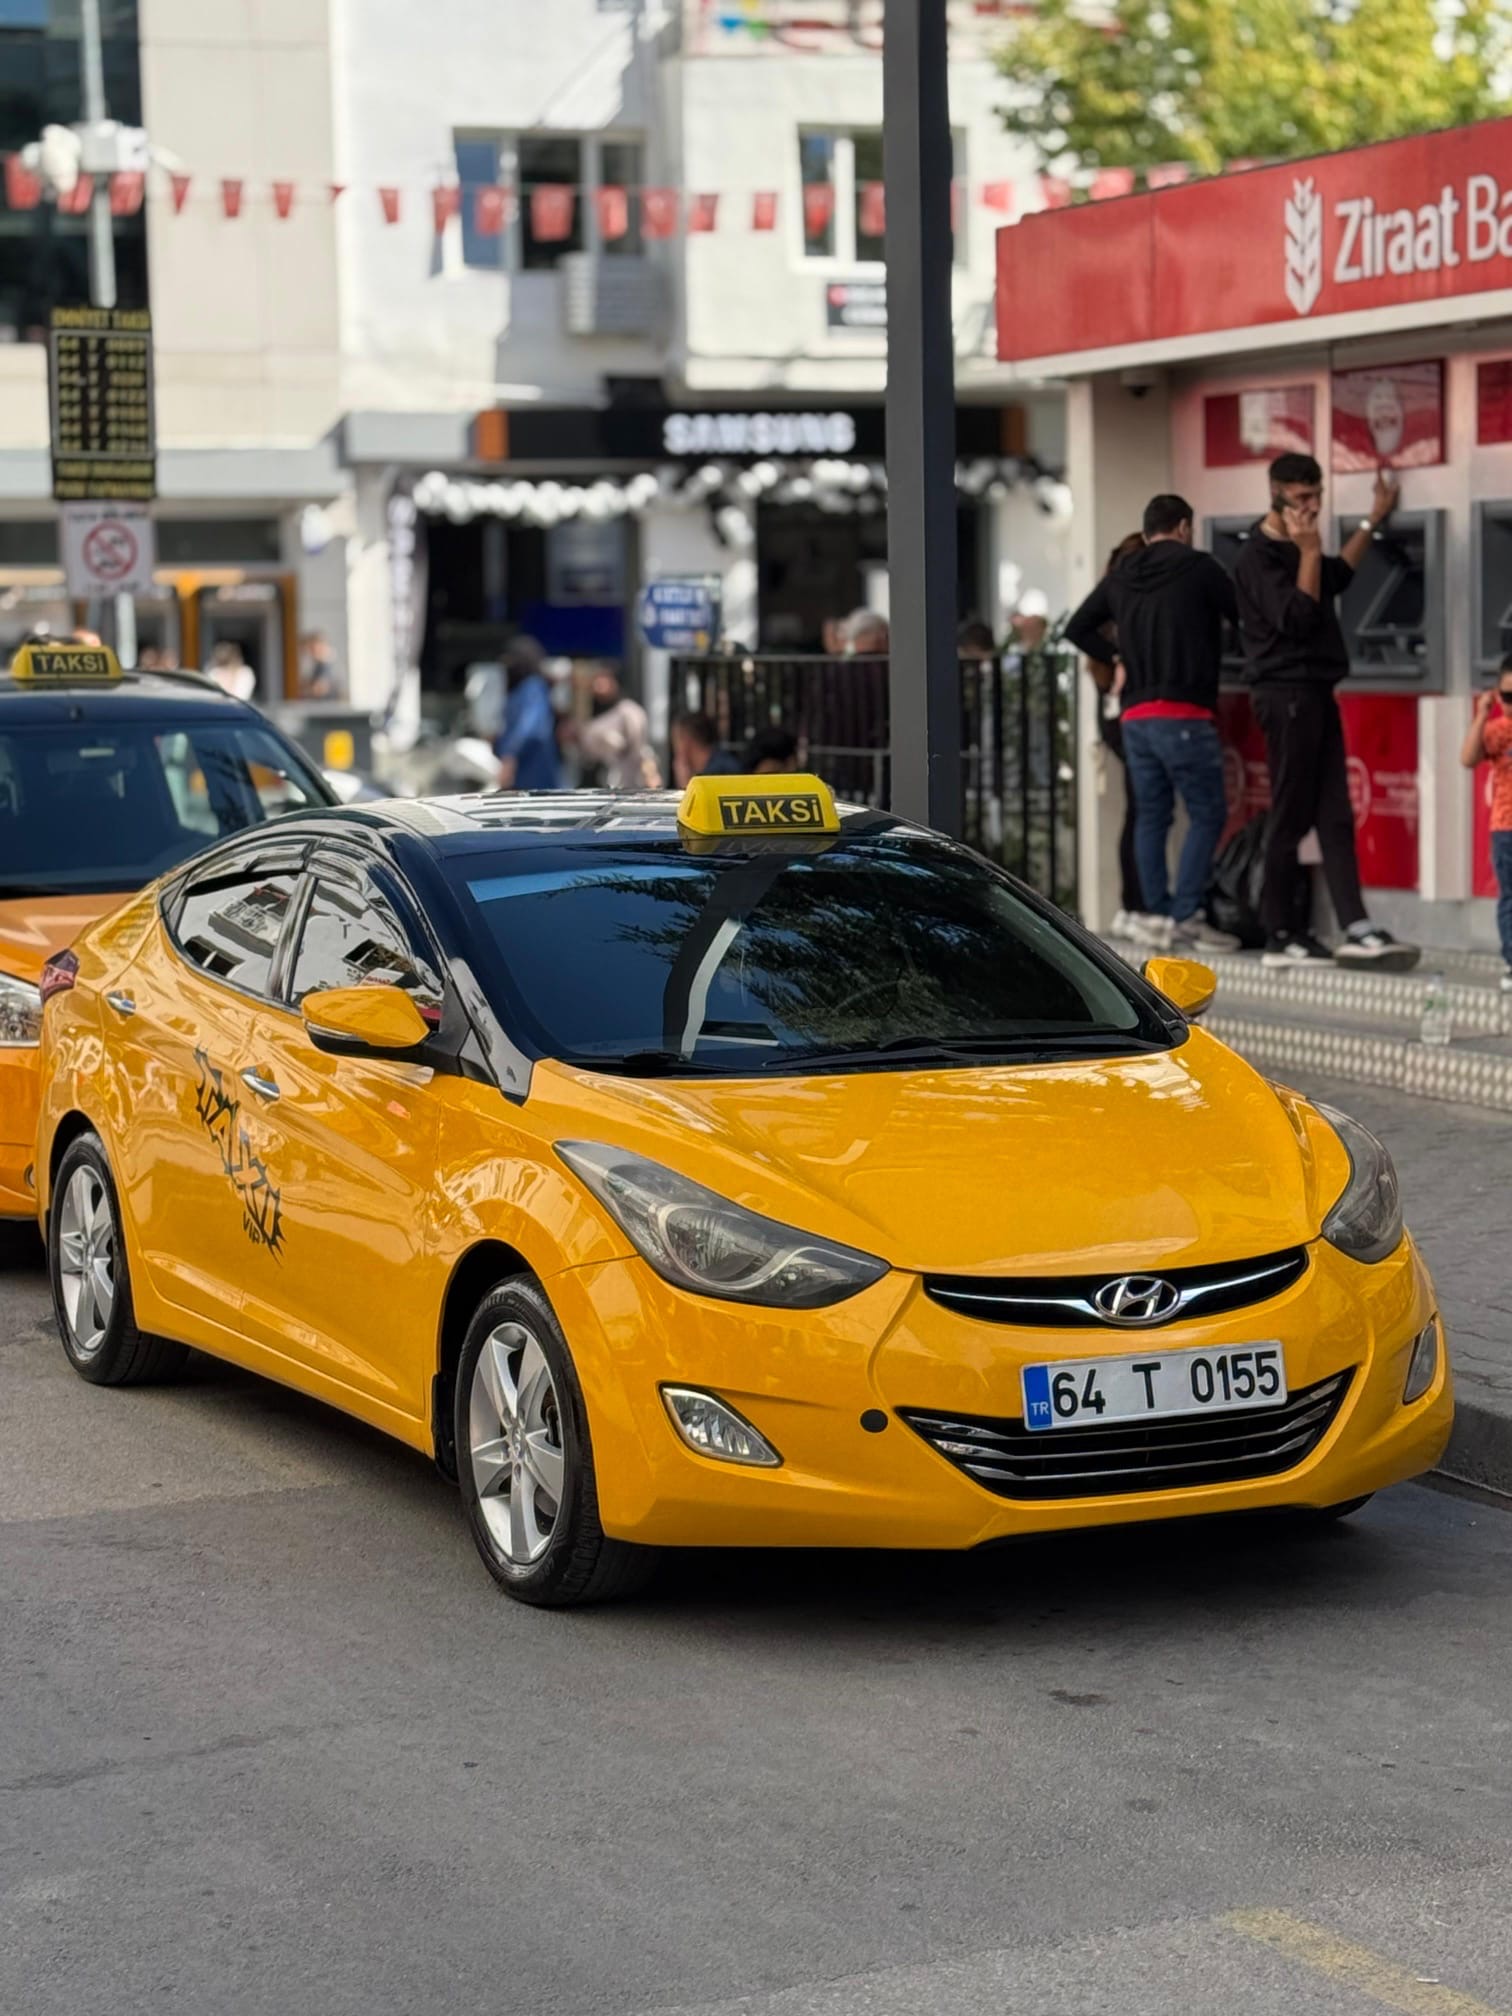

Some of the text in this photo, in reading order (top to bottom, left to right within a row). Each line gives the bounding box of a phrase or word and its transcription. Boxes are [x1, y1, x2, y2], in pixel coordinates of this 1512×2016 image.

[1333, 184, 1460, 284] Ziraat
[663, 412, 855, 454] SAMSUNG
[1031, 1350, 1280, 1418] TR 64 T 0155
